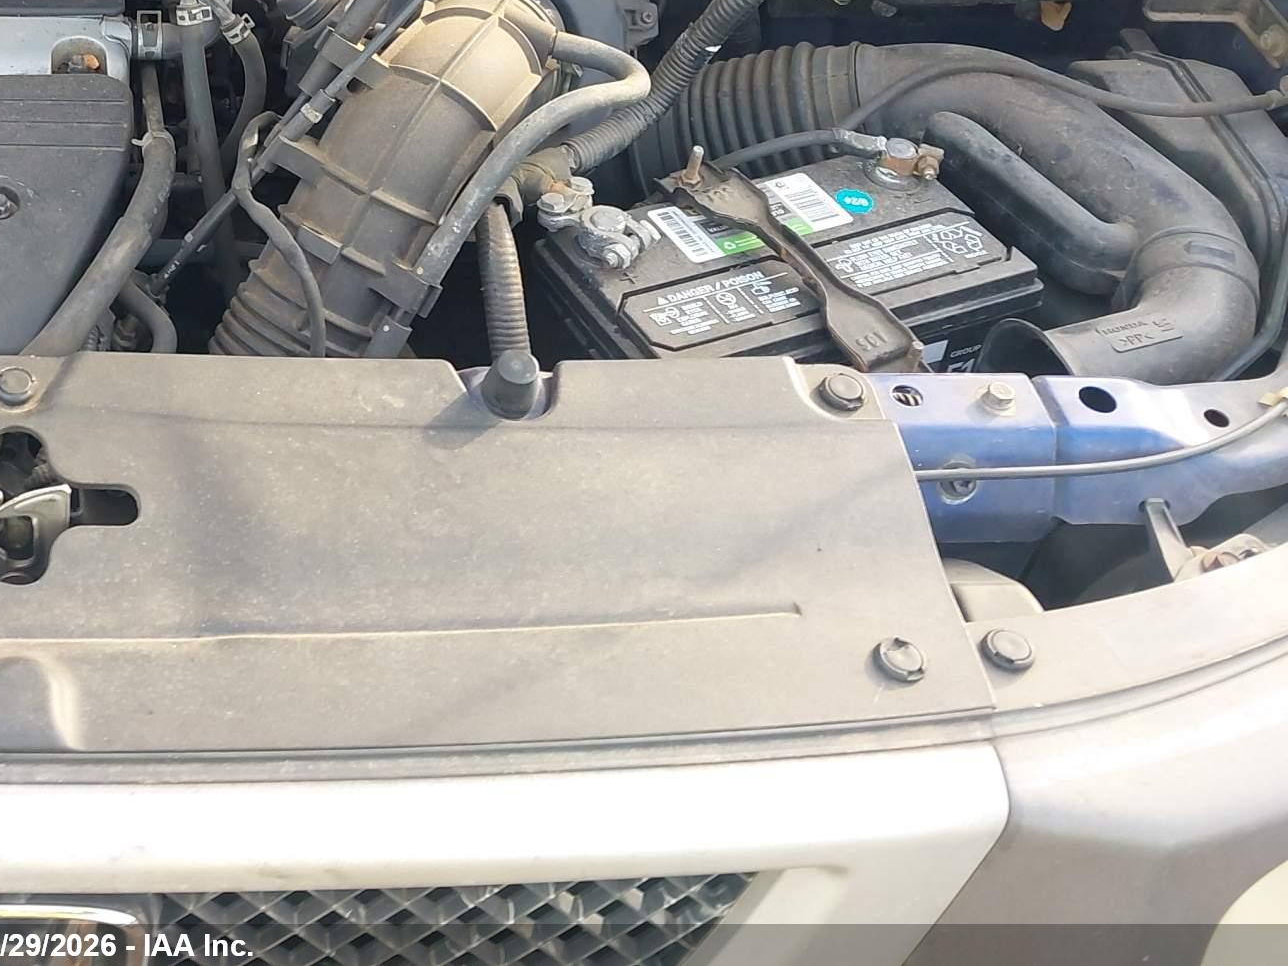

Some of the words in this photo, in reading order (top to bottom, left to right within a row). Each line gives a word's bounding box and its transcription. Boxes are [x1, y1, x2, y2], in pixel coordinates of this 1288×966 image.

[667, 285, 715, 302] DANGER
[721, 271, 765, 288] POISON
[950, 344, 982, 358] GROUP
